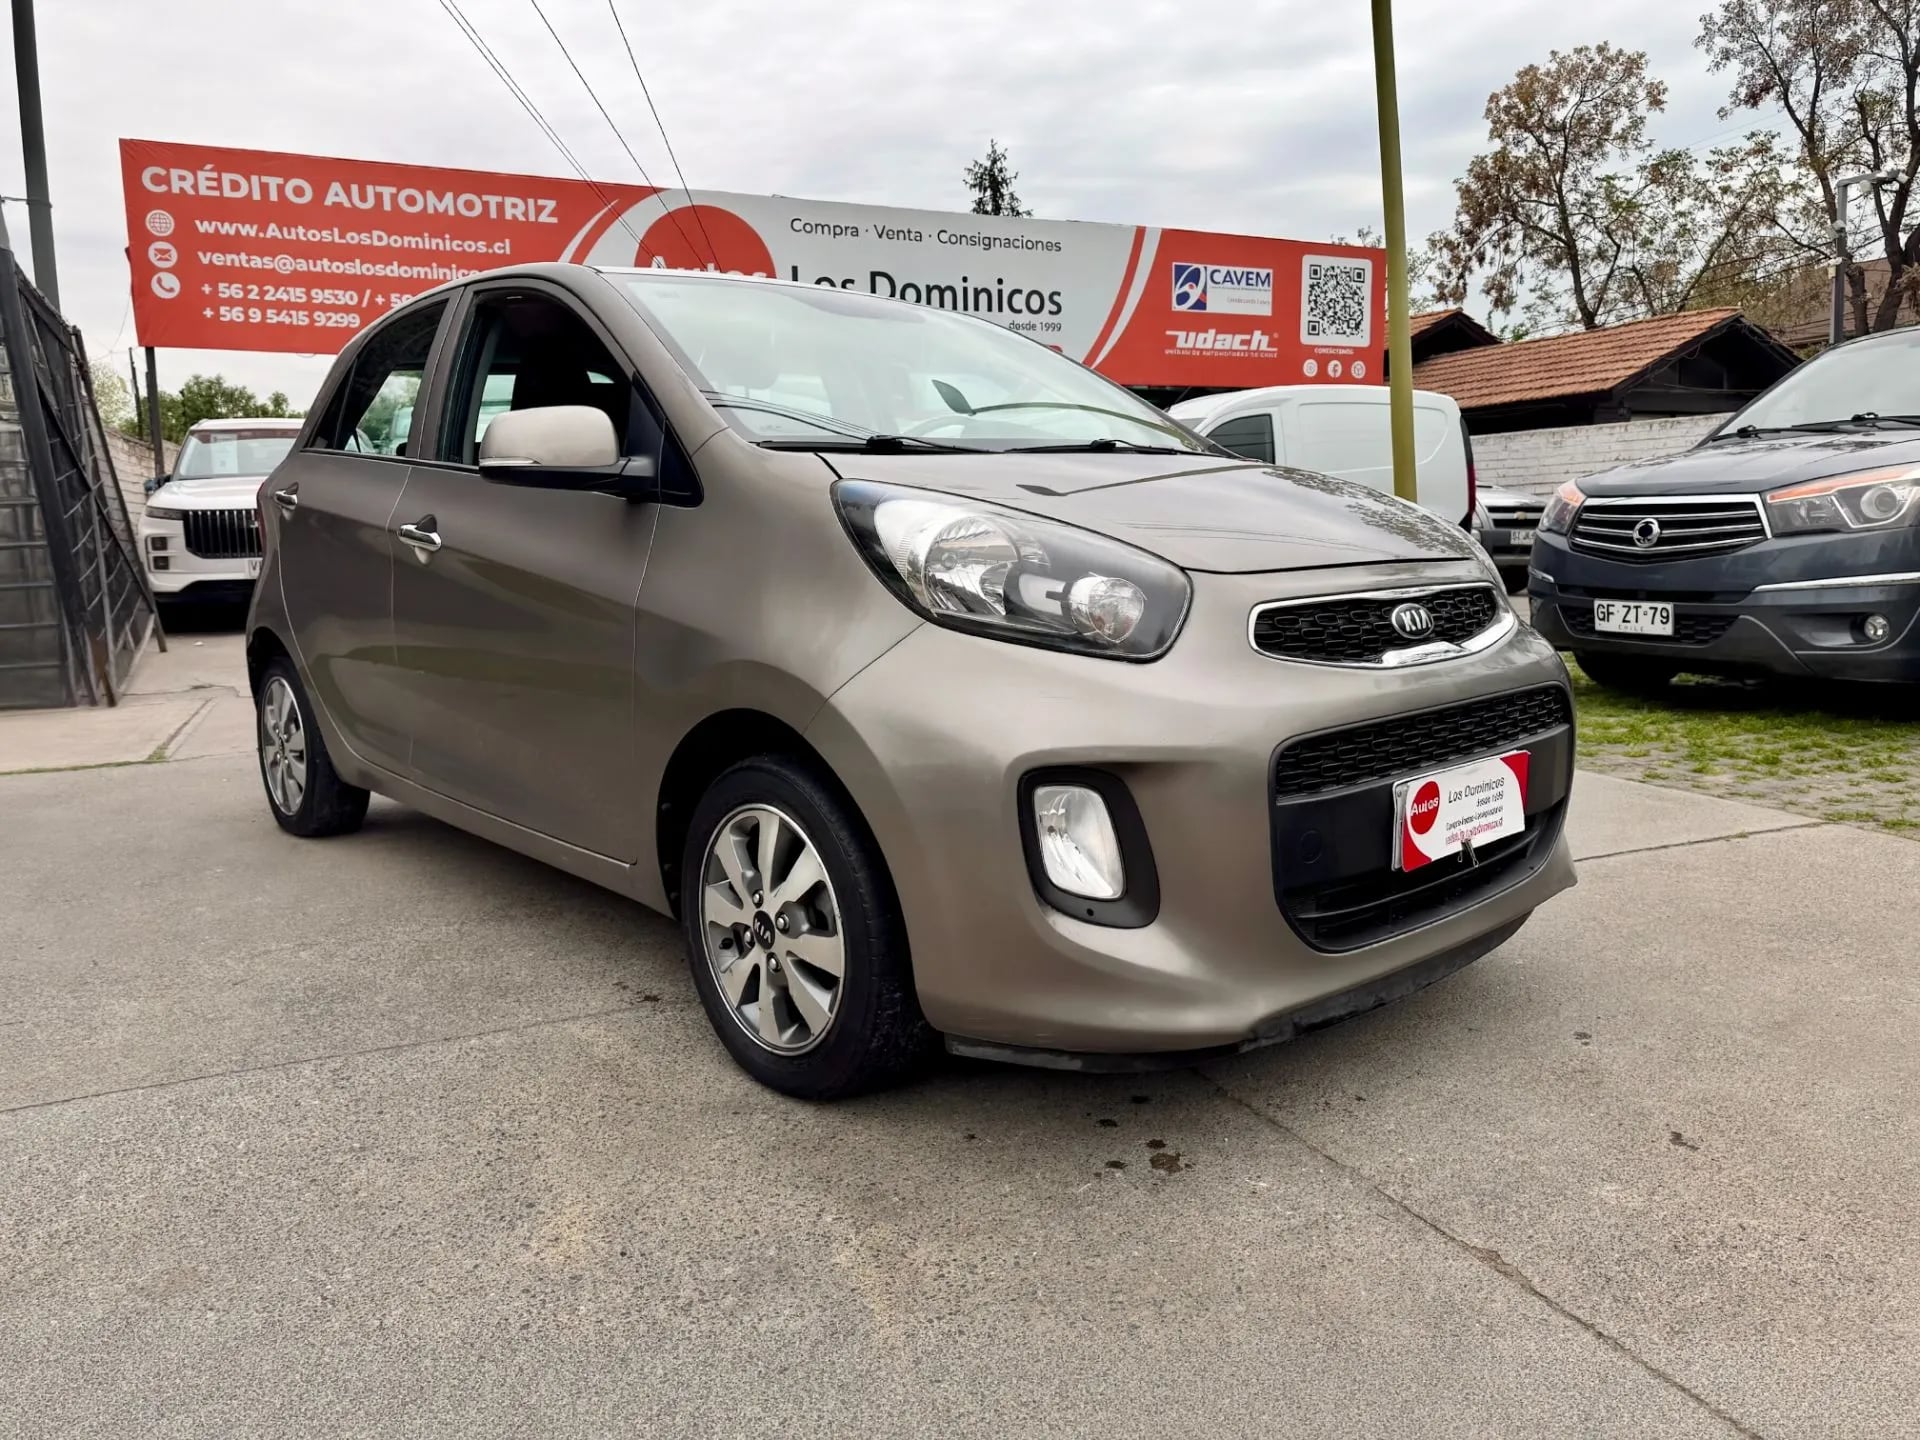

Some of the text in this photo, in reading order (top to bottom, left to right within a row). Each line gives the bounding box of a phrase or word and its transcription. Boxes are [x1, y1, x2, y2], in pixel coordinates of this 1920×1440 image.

[141, 164, 559, 224] CRÉDITO AUTOMOTRIZ
[195, 217, 511, 256] www.AutosLosDominicos.cl
[790, 218, 1062, 252] Compra Venta Consignaciones
[1210, 268, 1271, 288] CAVEM
[217, 282, 244, 300] 56
[249, 284, 260, 301] 2
[264, 285, 307, 304] 2415
[311, 288, 359, 307] 9530
[869, 271, 1062, 316] Dominicos
[219, 305, 245, 323] 56
[249, 307, 261, 324] 9
[266, 308, 310, 327] 5415
[313, 310, 360, 329] 9299
[1009, 320, 1062, 332] desde 1999
[1401, 609, 1430, 632] KIA
[1410, 776, 1505, 817] Autos Los Dominicos
